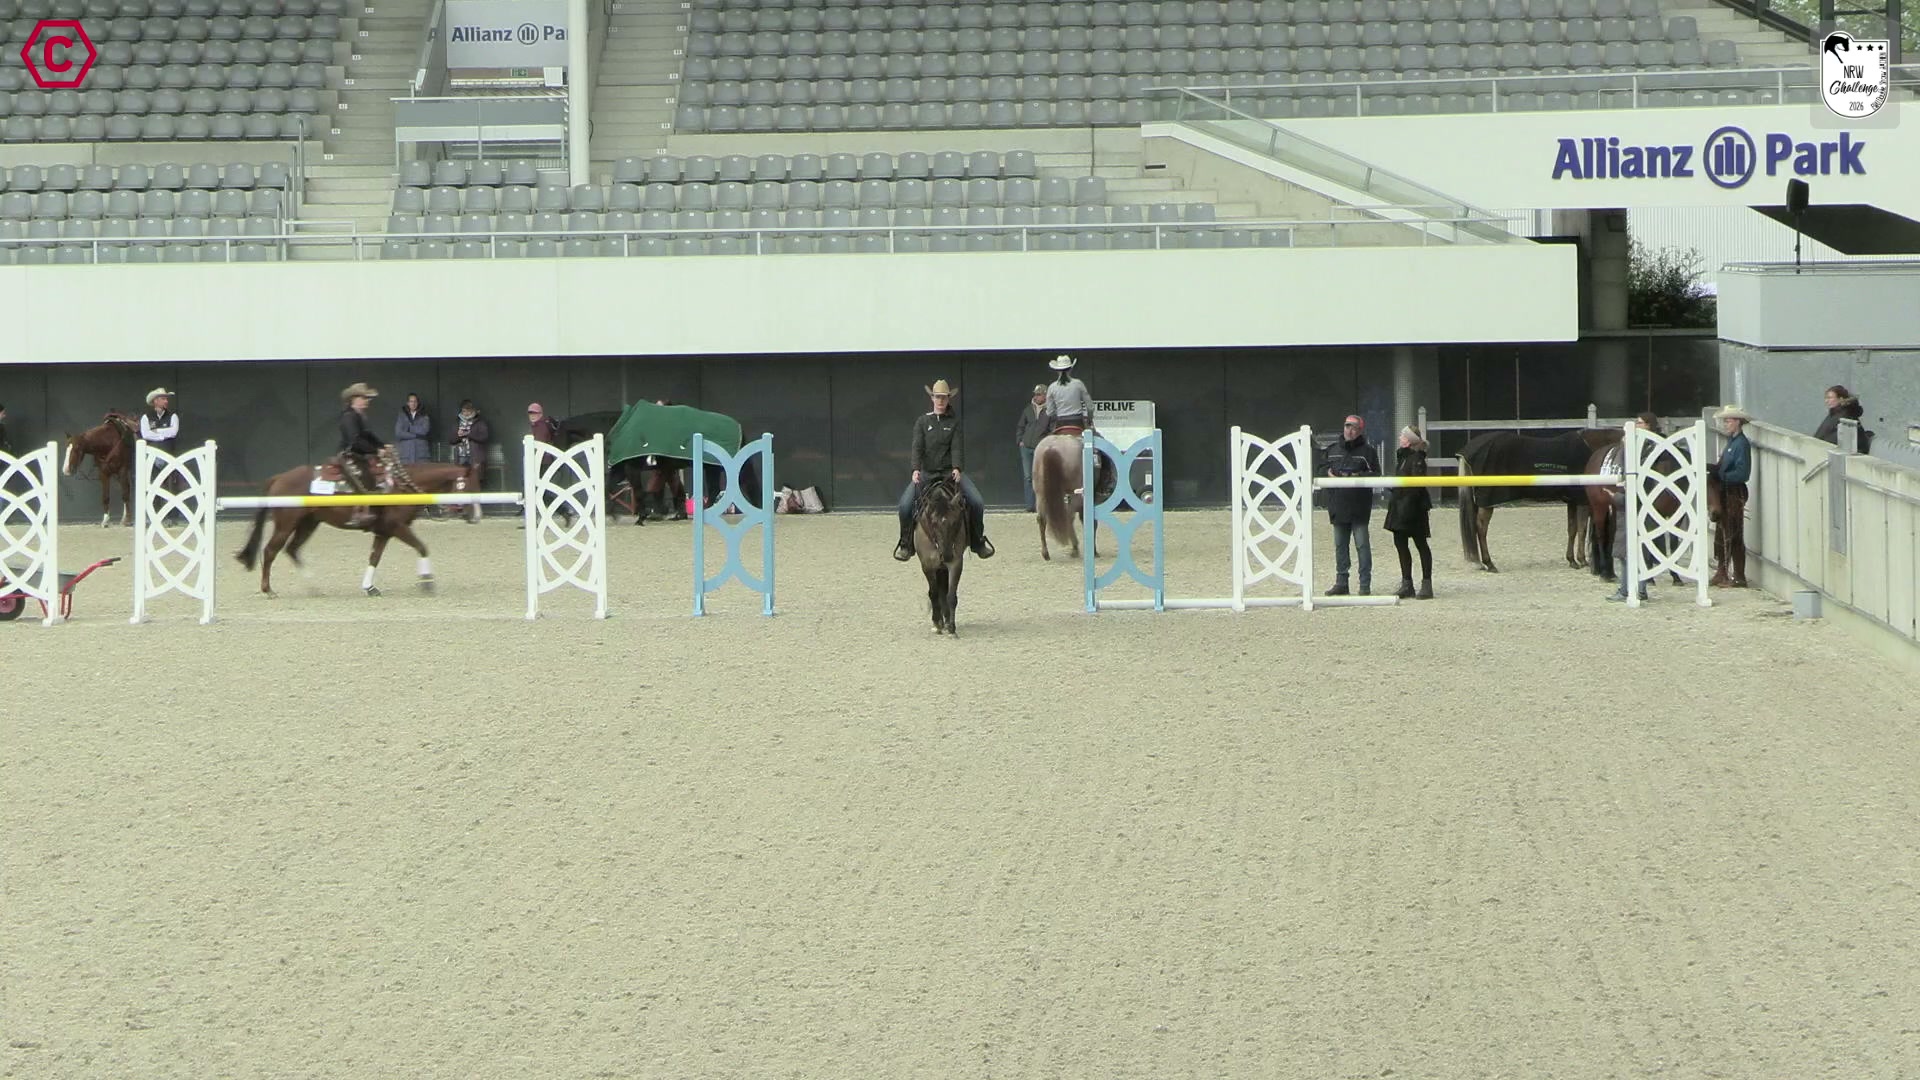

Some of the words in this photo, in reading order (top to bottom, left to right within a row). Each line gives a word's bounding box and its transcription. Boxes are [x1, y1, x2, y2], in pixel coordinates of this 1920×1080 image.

[452, 26, 512, 42] Allianz
[1552, 137, 1694, 179] Allianz
[1765, 132, 1867, 176] Park
